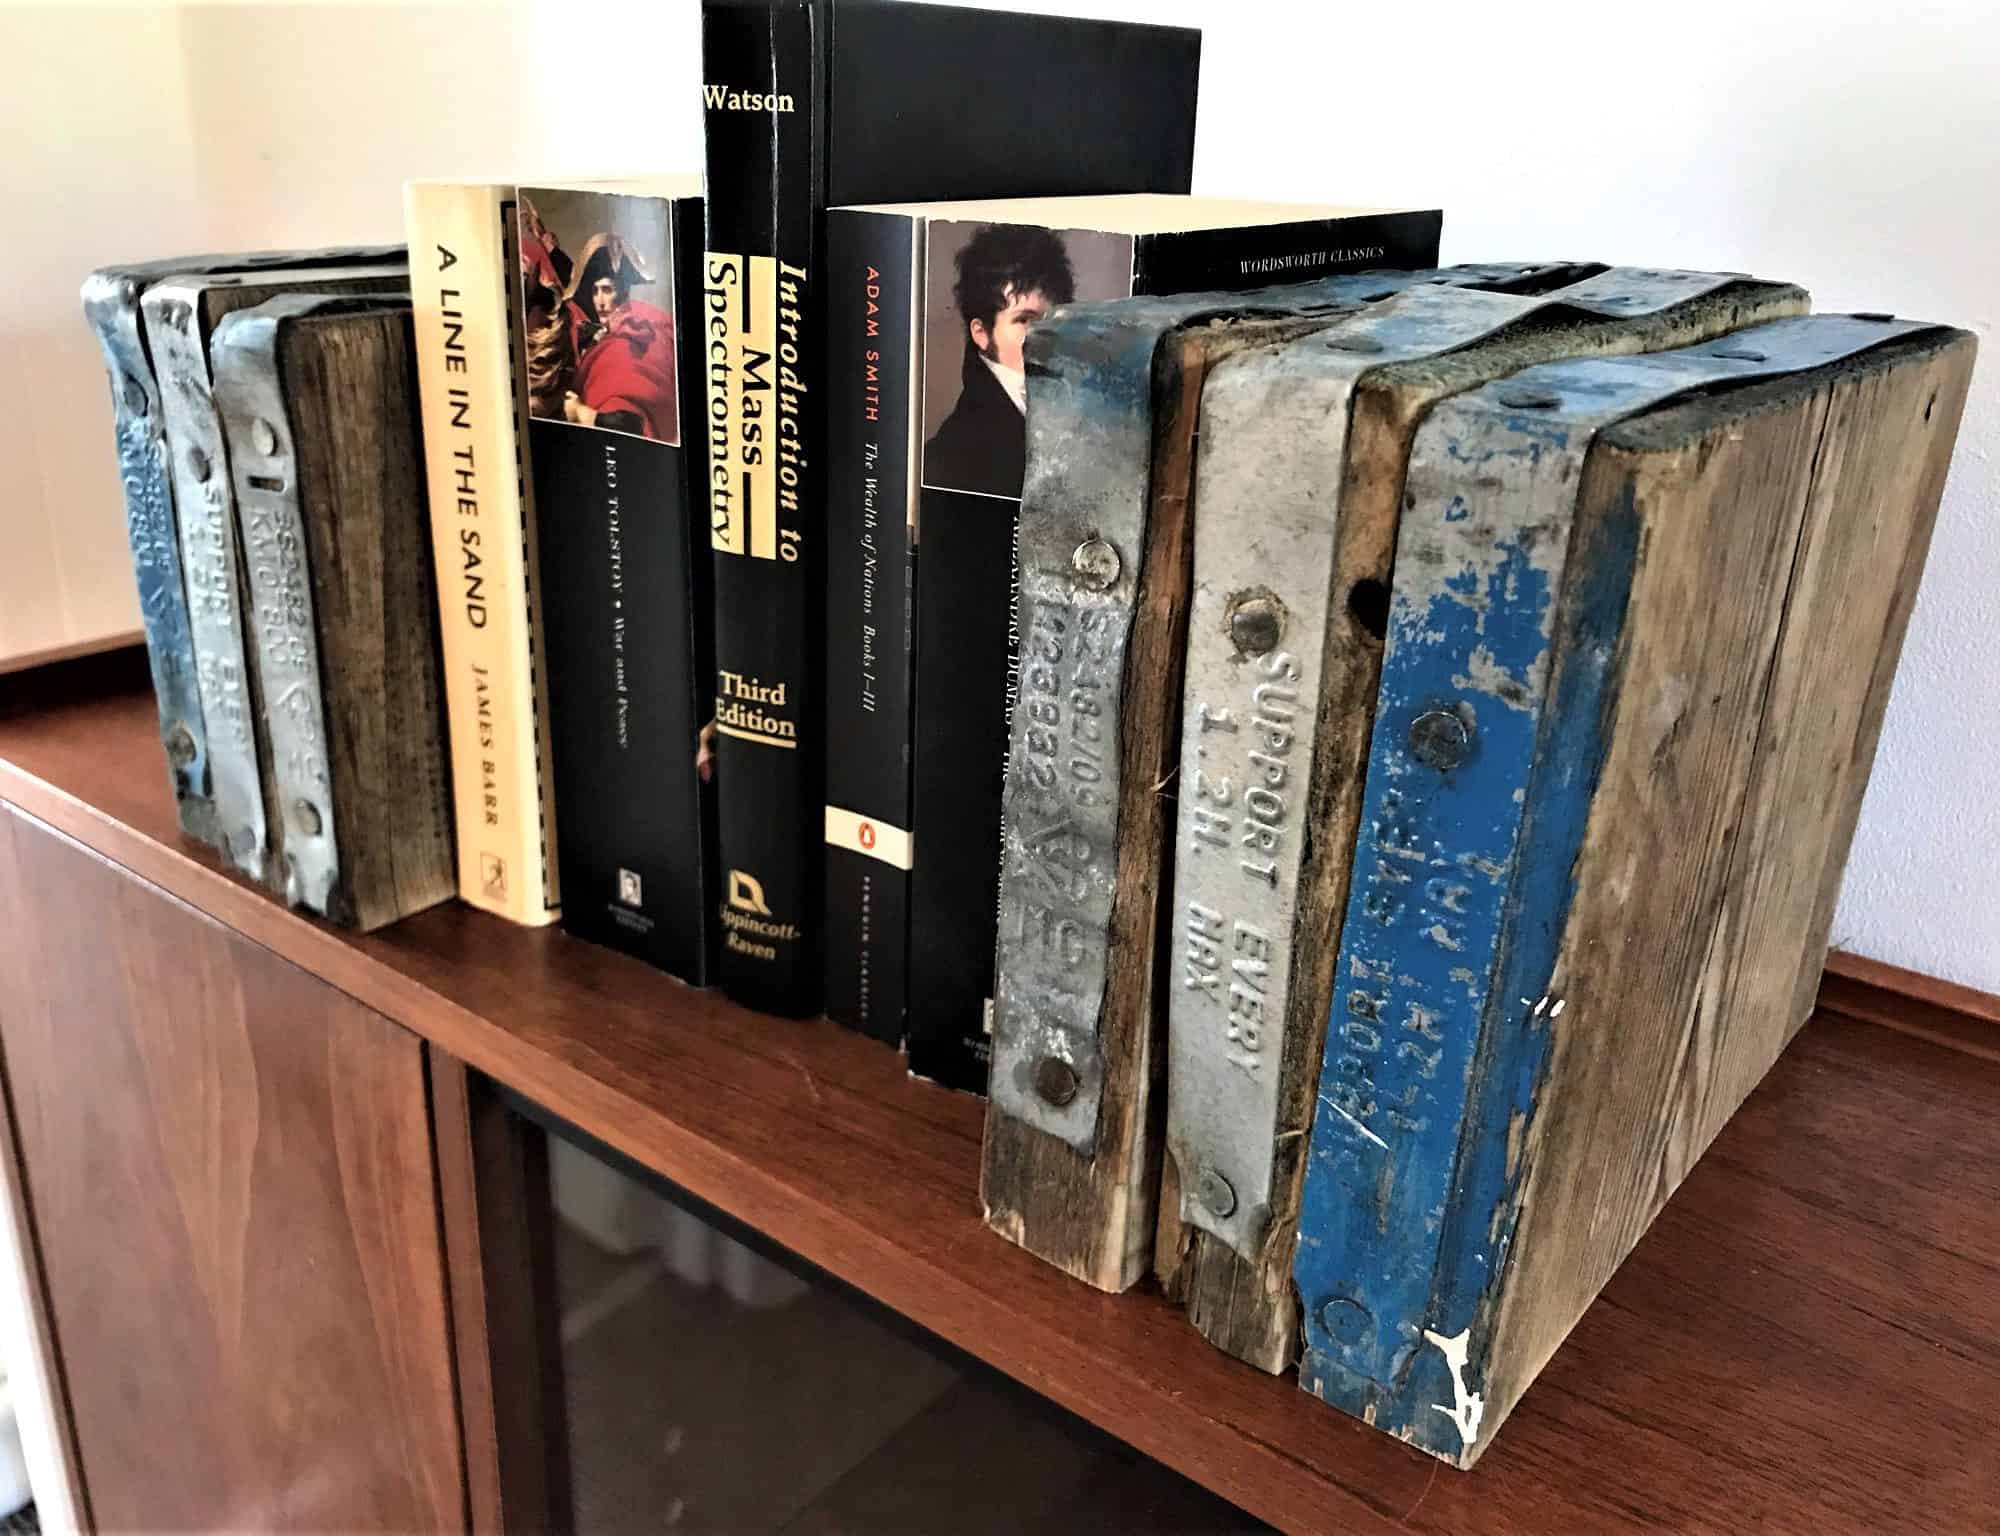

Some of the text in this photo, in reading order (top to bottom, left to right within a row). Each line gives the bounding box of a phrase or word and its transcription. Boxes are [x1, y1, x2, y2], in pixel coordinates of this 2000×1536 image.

[702, 84, 795, 113] Watson
[1240, 246, 1385, 275] WORDSWORTH CLASSICS
[704, 260, 737, 545] Spectrometry
[742, 345, 772, 466] Mass
[865, 265, 880, 421] ADAM SMITH
[436, 244, 488, 630] A LINE IN THE SAND
[779, 260, 808, 562] Introduction to
[604, 445, 625, 593] LEO TOLSTOY
[860, 443, 879, 614] The Wealth of Nations
[614, 656, 629, 692] and
[718, 669, 786, 706] Third
[863, 624, 876, 675] Books
[471, 664, 500, 827] JAMES BARR
[716, 696, 797, 738] Edition
[1227, 652, 1300, 1085] SUPPORT EVERY
[1184, 901, 1224, 1002] MAX
